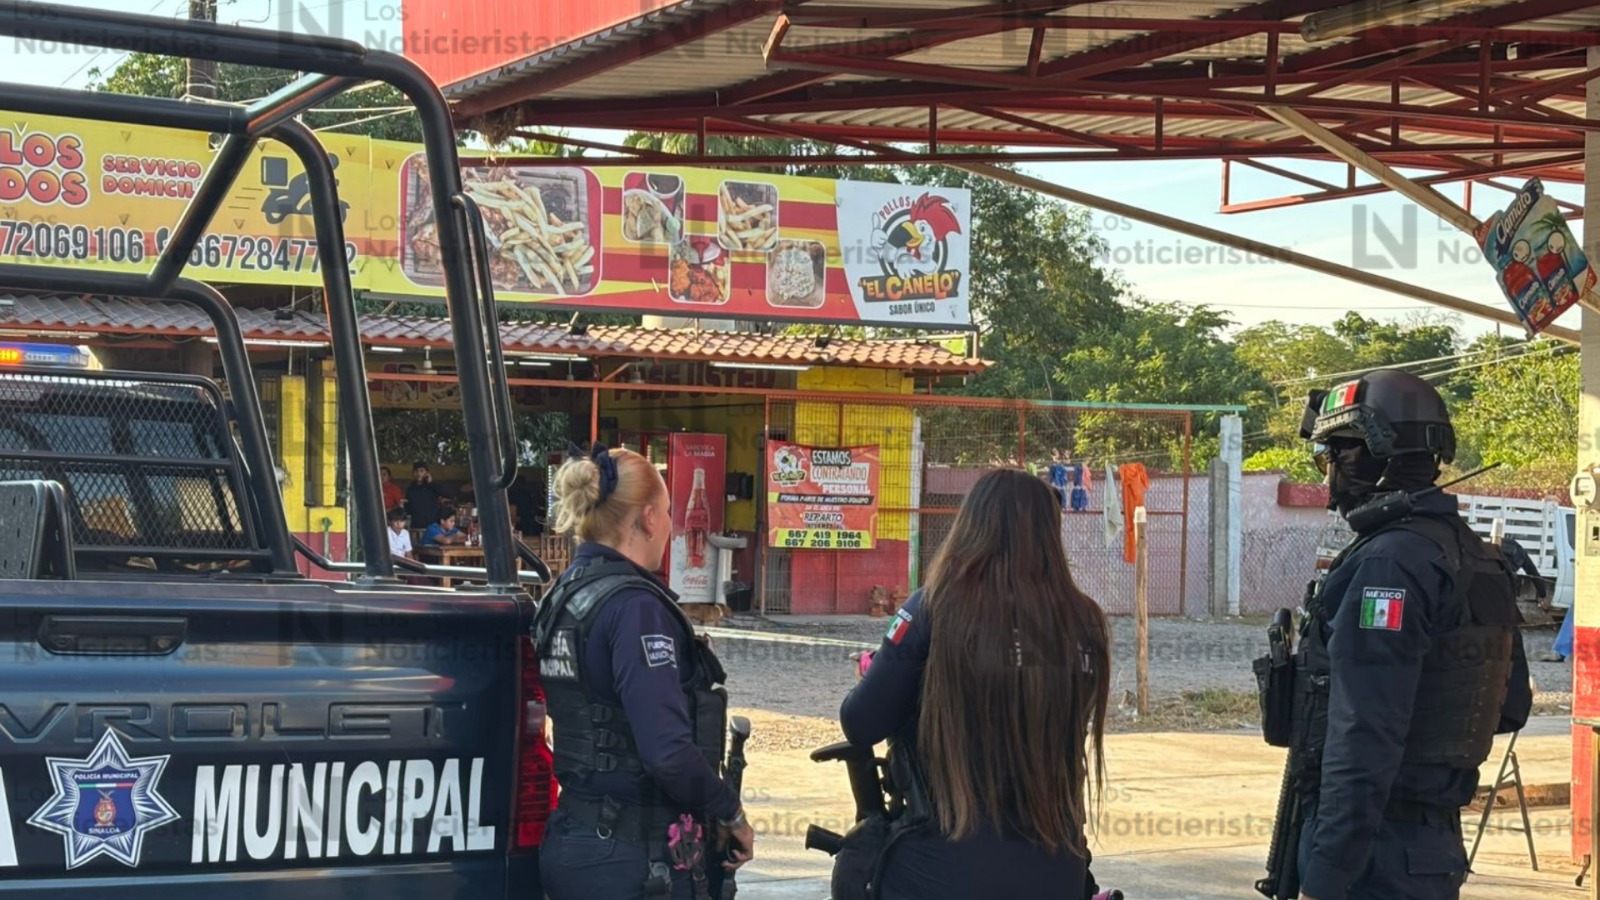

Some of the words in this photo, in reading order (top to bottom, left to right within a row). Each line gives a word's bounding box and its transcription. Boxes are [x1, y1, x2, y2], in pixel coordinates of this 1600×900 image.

[103, 156, 201, 179] SERVICIO
[103, 175, 198, 199] DOMICIL
[879, 196, 911, 221] POLLOS
[1496, 191, 1532, 245] Clamato
[889, 304, 913, 316] SABOR
[914, 300, 936, 314] ÚNICO
[812, 450, 851, 465] ESTAMOS
[812, 466, 868, 481] CONTRATANDO
[822, 484, 871, 495] PERSONAL
[804, 513, 843, 522] REPARTO
[788, 529, 808, 538] 667
[813, 531, 831, 539] 419
[837, 531, 862, 539] 1964
[785, 538, 805, 547] 667
[836, 540, 861, 548] 9106
[191, 757, 496, 864] MUNICIPAL
